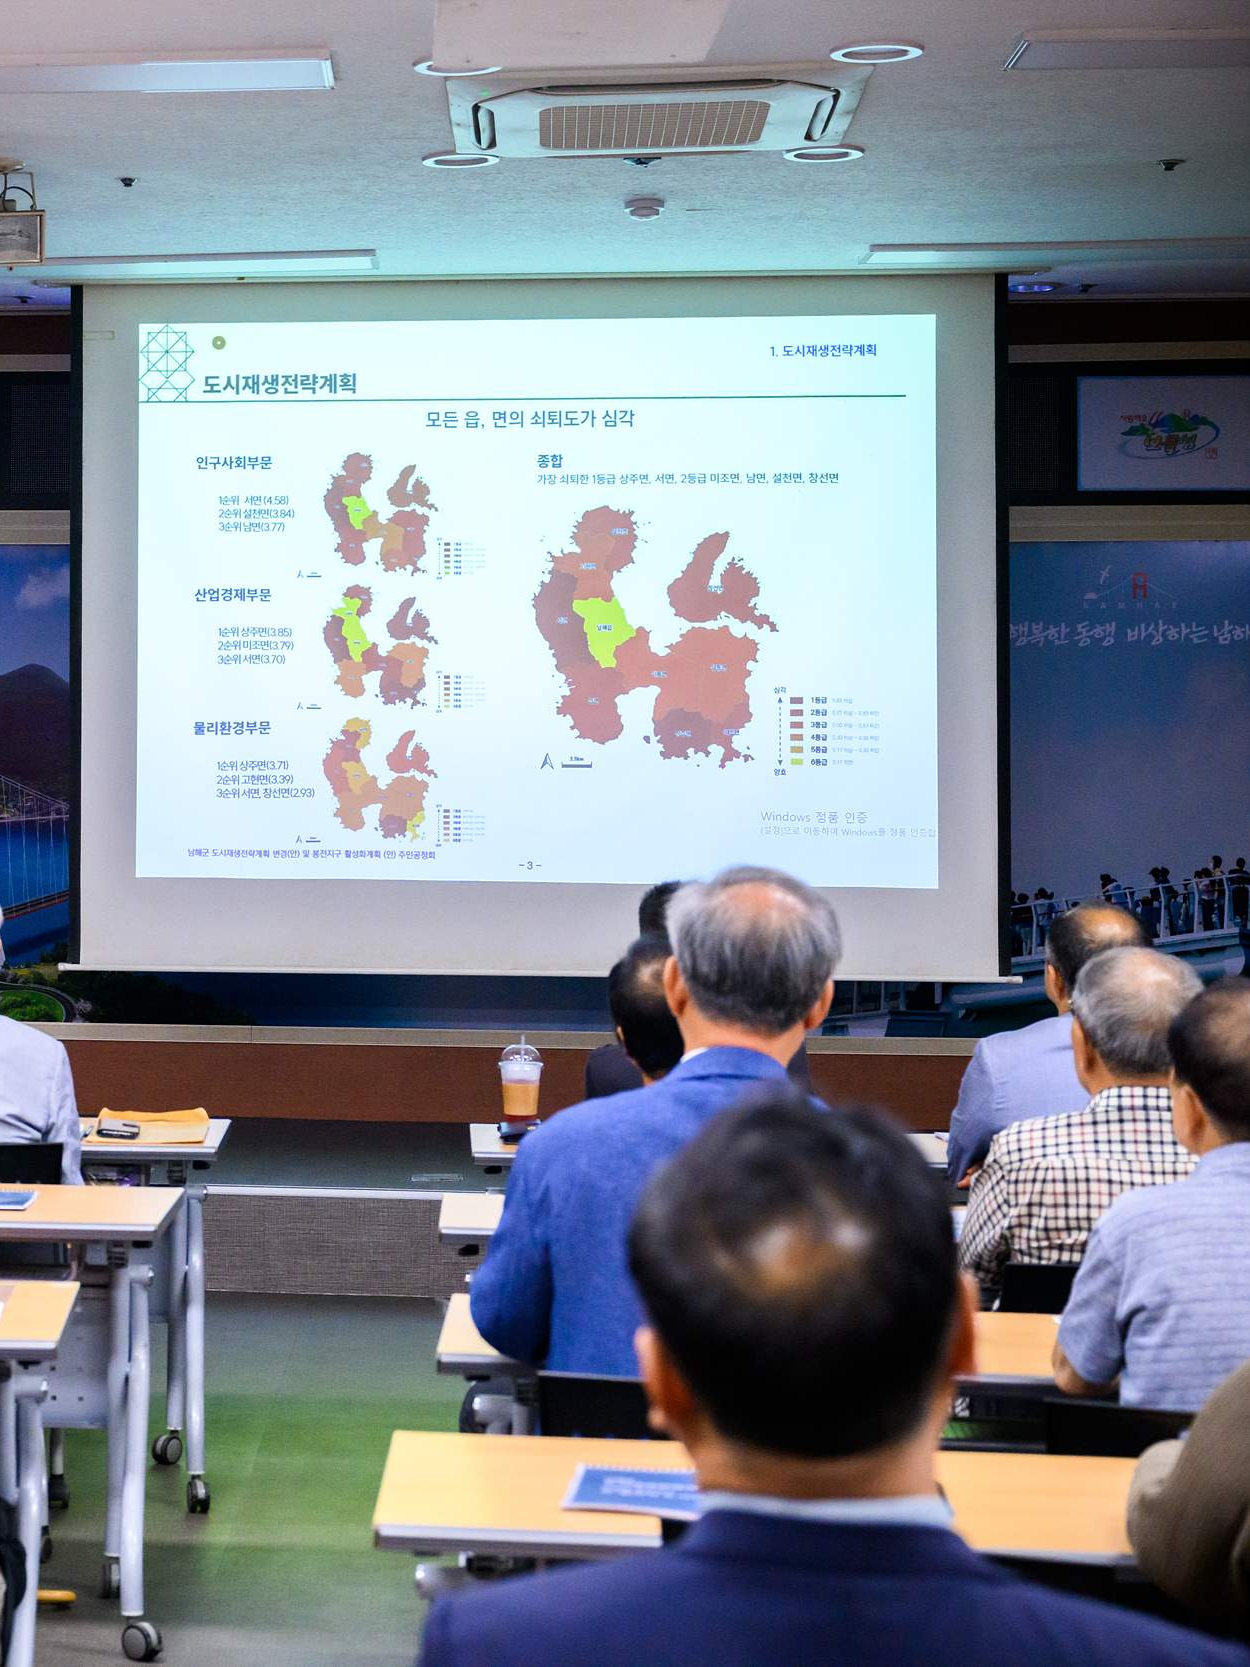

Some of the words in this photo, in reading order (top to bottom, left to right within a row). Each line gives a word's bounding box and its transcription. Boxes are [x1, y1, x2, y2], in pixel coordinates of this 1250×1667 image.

[782, 344, 877, 358] 도시재생전략계획
[203, 372, 357, 396] 도시재생전략계획
[426, 411, 459, 429] 모든
[463, 410, 486, 430] 읍,
[492, 410, 524, 429] 면의
[530, 409, 597, 429] 쇠퇴도가
[602, 409, 636, 428] 심각
[196, 455, 273, 471] 인구사회부문
[537, 453, 563, 469] 종합
[537, 474, 557, 485] 가장
[560, 474, 589, 485] 쇠퇴한
[592, 474, 617, 485] 1등급
[680, 473, 707, 485] 2등급
[808, 472, 839, 484] 창선면
[218, 495, 240, 506] 1순위
[218, 508, 242, 519] 2순위
[218, 521, 242, 533] 3순위
[195, 587, 272, 603] 산업경제부문
[218, 626, 240, 638] 1순위
[1073, 620, 1116, 647] 동행
[1127, 619, 1210, 646] 비상하는
[217, 640, 242, 651] 2순위
[217, 653, 242, 665] 3순위
[194, 720, 271, 736] 물리환경부문
[216, 760, 238, 772] 1순위
[216, 774, 240, 786] 2순위
[216, 788, 240, 799] 3순위
[760, 810, 811, 823] Windows
[816, 811, 840, 824] 정품
[845, 811, 869, 824] 인증
